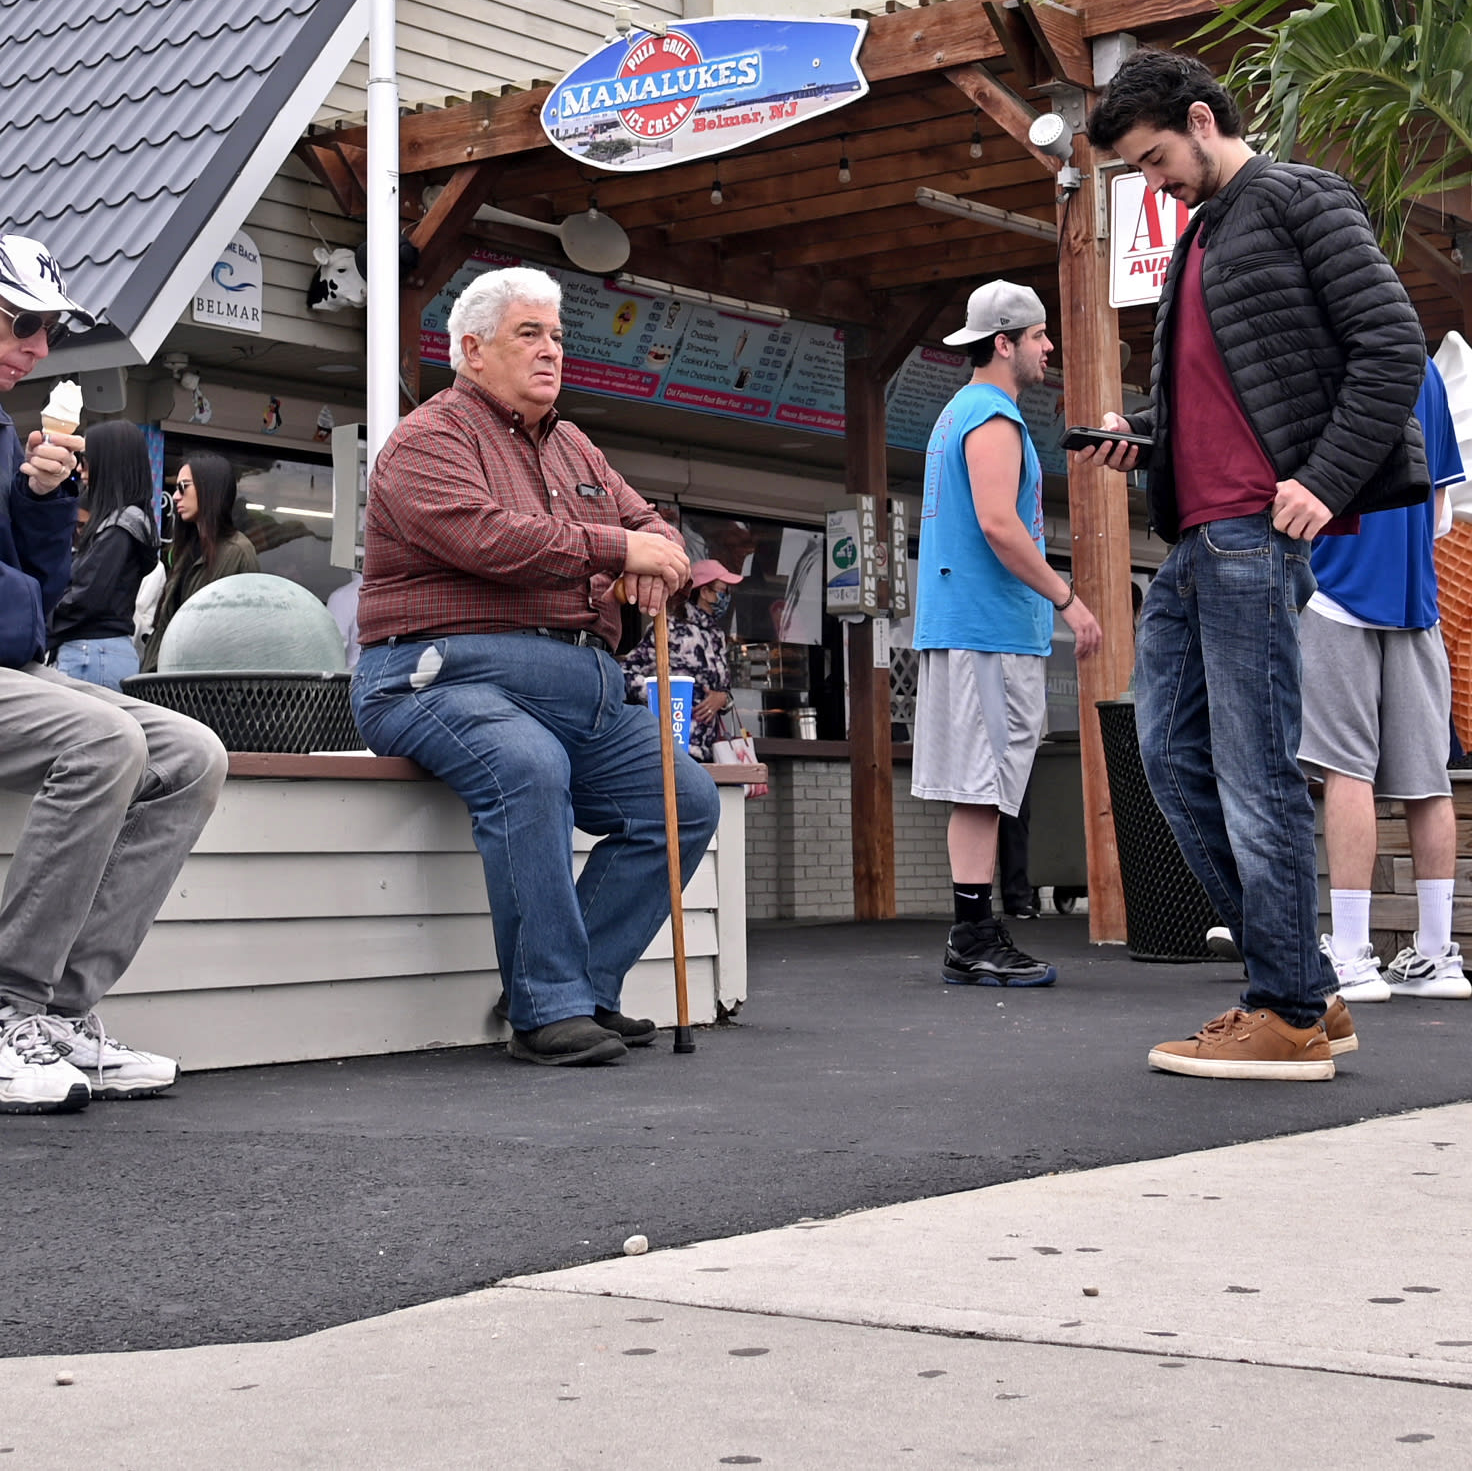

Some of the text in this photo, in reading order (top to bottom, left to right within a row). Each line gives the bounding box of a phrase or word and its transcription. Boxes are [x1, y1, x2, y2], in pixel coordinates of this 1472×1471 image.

[626, 37, 691, 71] PIZZA GRILL
[562, 54, 759, 117] MAMALUKES
[625, 102, 688, 136] ICE CREAM
[769, 102, 799, 121] NJ
[238, 243, 258, 265] BACK
[196, 297, 260, 322] BELMAR
[861, 496, 876, 607] NAPKINS
[893, 500, 906, 610] NAPKINS
